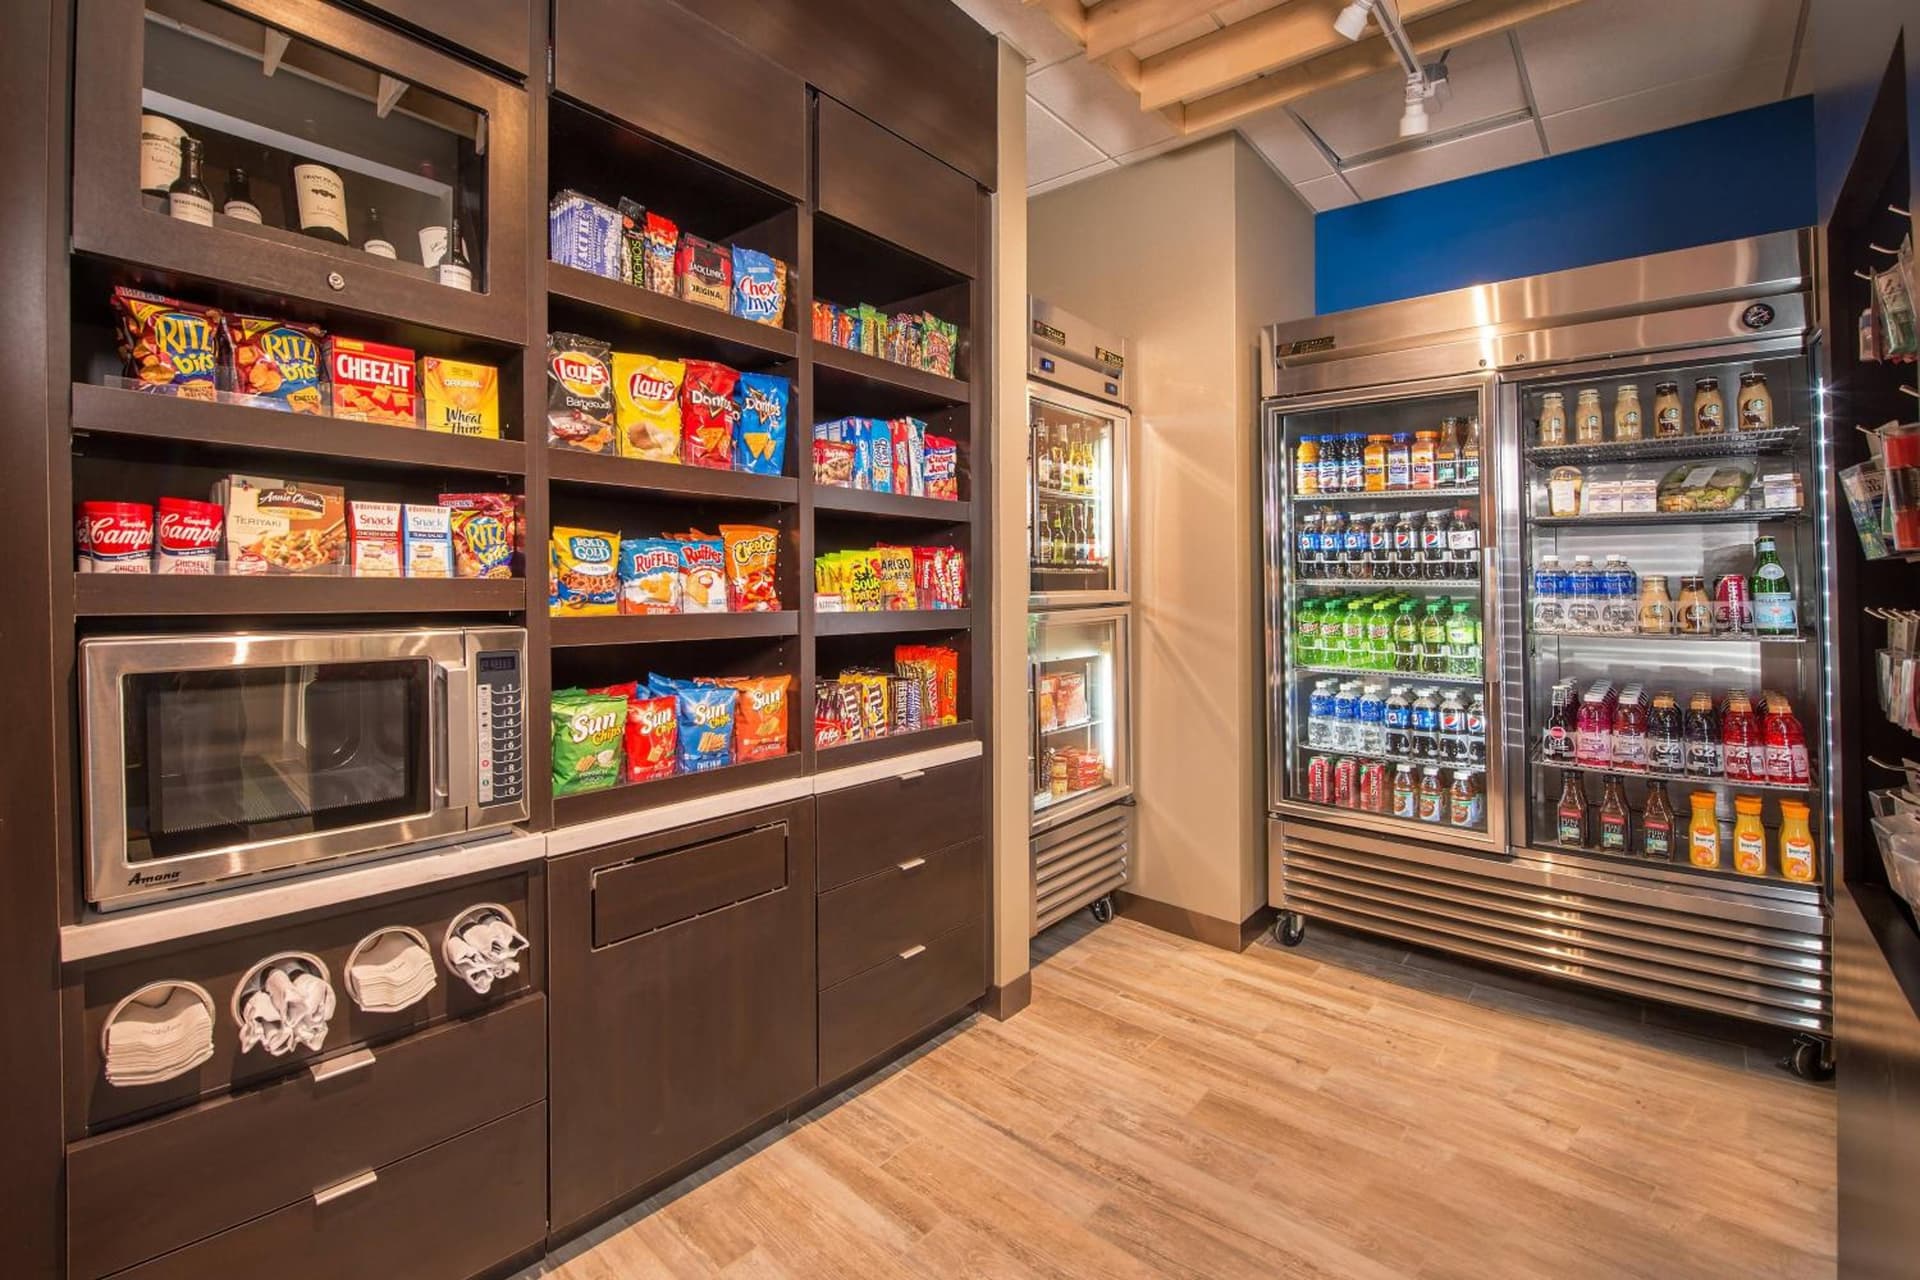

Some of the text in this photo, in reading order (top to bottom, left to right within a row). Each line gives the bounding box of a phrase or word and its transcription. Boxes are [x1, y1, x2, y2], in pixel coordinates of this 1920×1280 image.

[740, 276, 776, 296] Chex
[156, 317, 214, 354] RITZ
[262, 334, 313, 362] RITZ
[172, 353, 215, 375] bits
[279, 363, 318, 381] bits
[336, 354, 410, 387] CHEEZ-IT
[559, 359, 604, 385] Lay's
[632, 374, 676, 399] Lay's
[445, 407, 482, 424] Wheat
[444, 423, 482, 435] Thins
[234, 515, 282, 527] TERIYAKI
[360, 514, 394, 526] Snack
[413, 516, 444, 527] Snack
[465, 523, 507, 550] RITZ
[735, 536, 776, 564] Cheetos
[635, 551, 678, 572] RUFFLES
[752, 690, 780, 711] Sun
[641, 708, 672, 734] Sun
[694, 703, 727, 725] Sun
[573, 712, 617, 743] Sun
[592, 727, 622, 745] Chips
[128, 871, 181, 886] Amana
